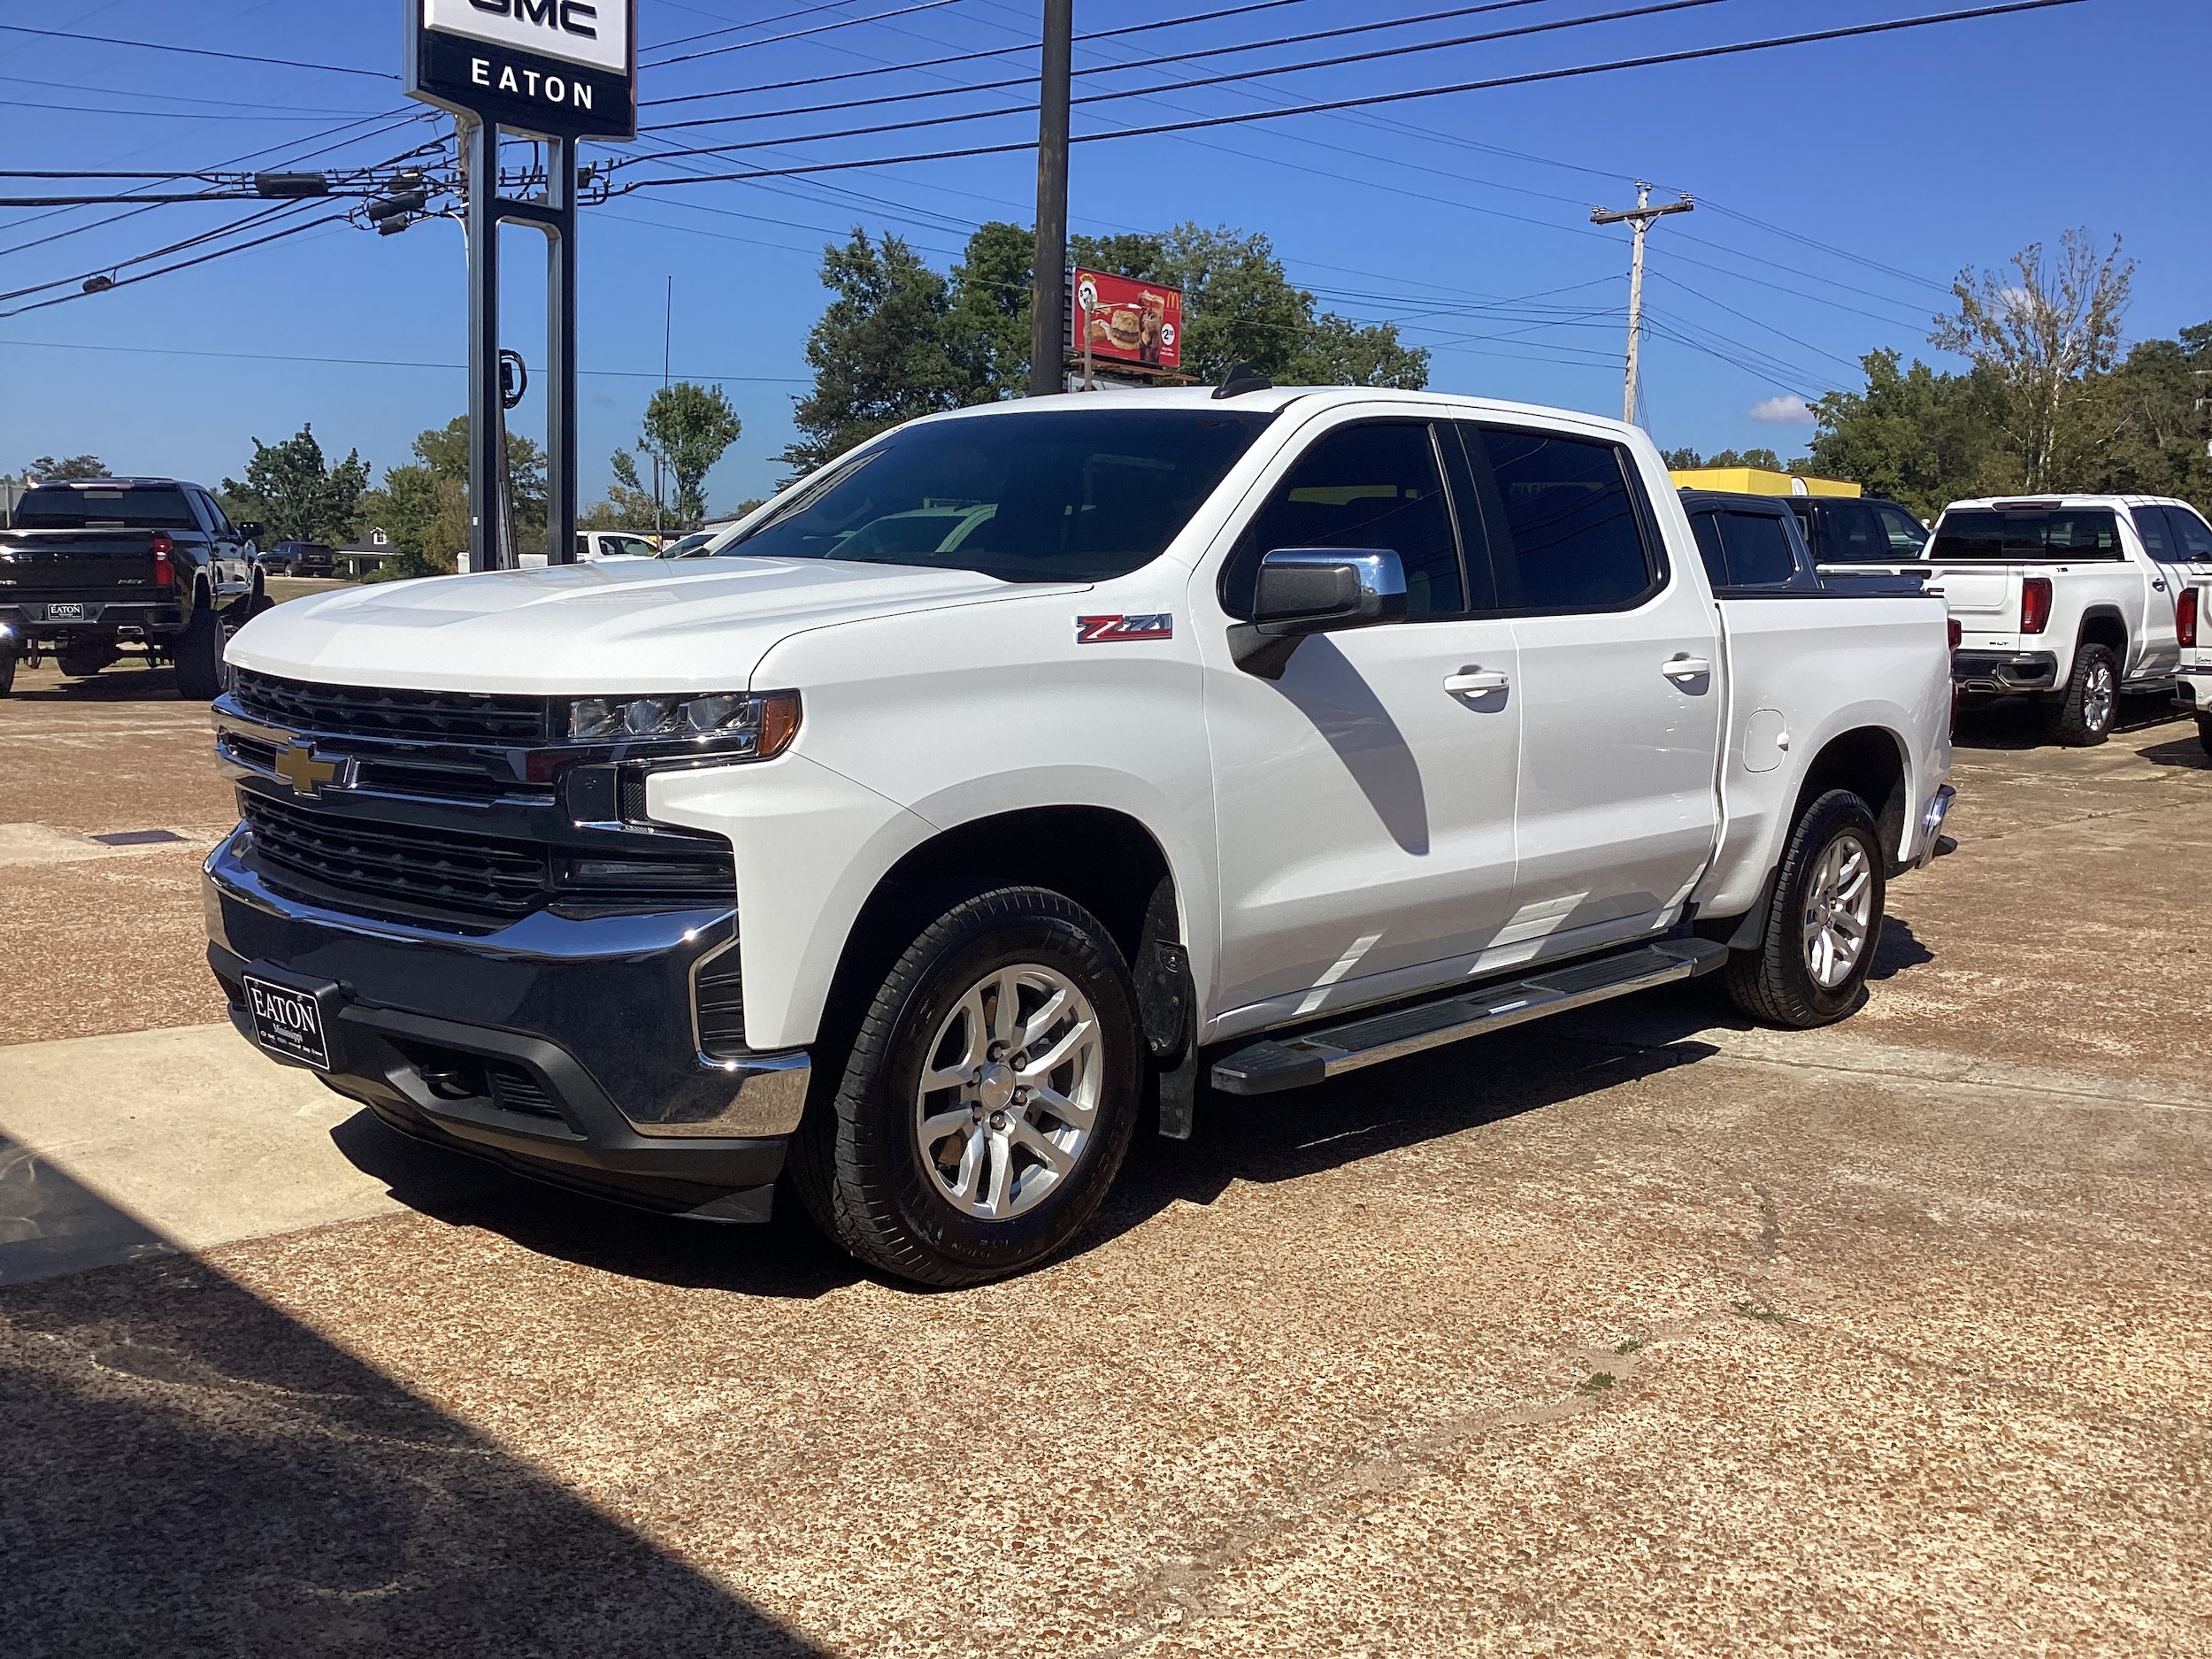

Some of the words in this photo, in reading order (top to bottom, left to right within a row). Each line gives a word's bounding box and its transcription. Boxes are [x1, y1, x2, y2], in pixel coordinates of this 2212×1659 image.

[471, 58, 592, 110] EATON
[1076, 613, 1172, 644] Z71
[250, 987, 317, 1035] EATON
